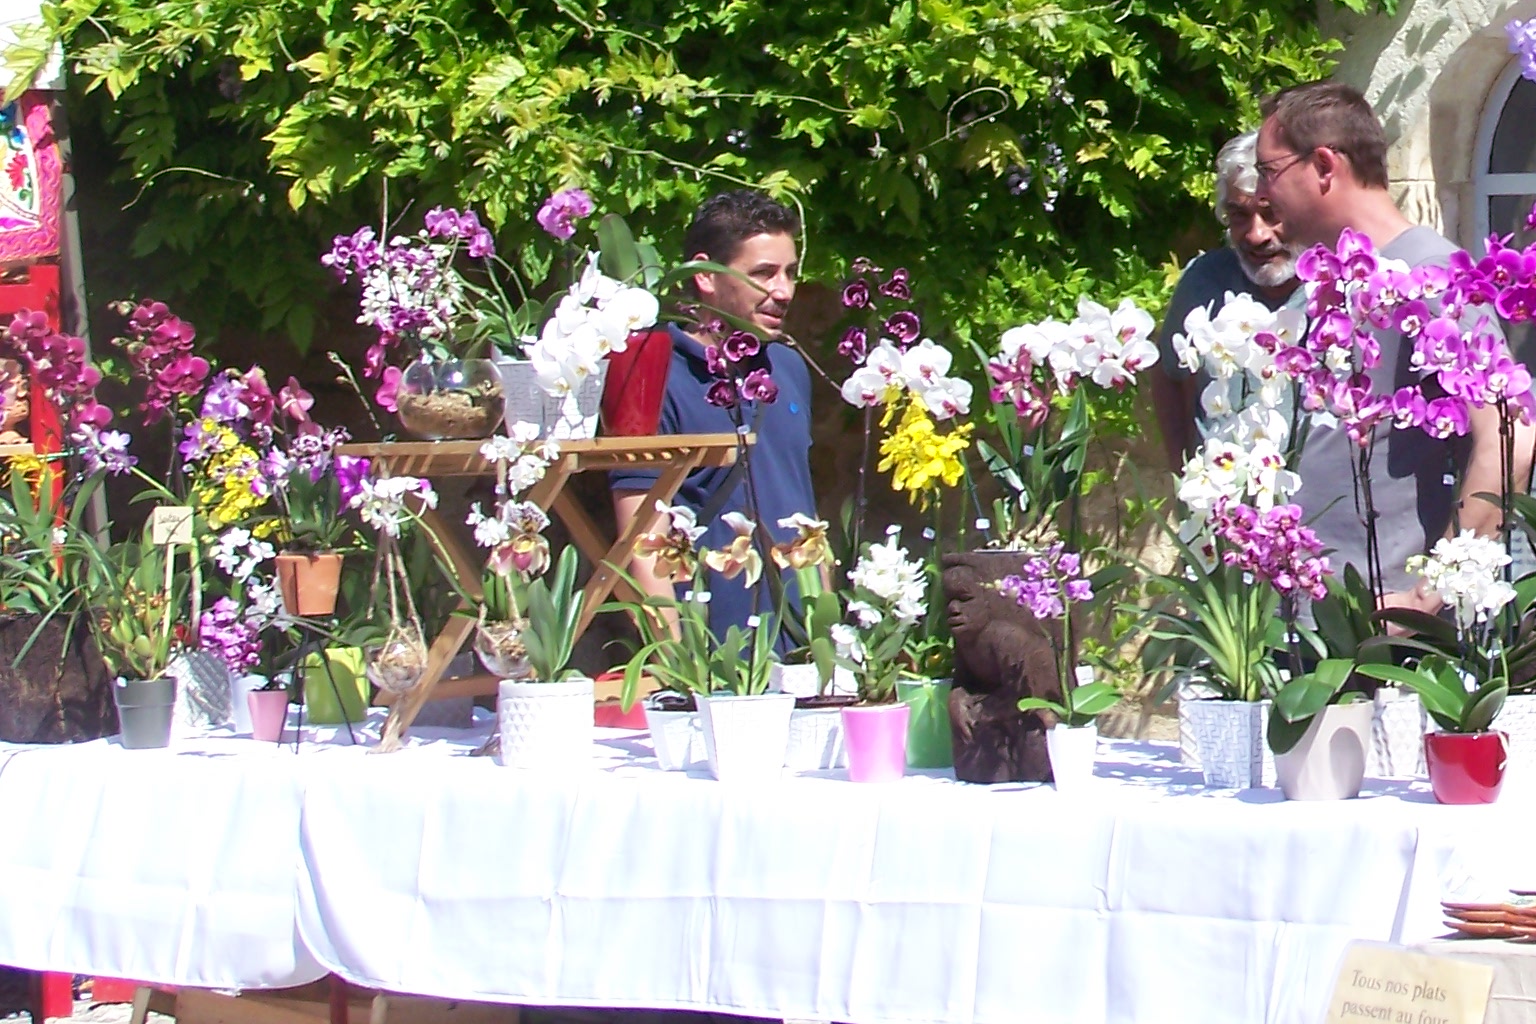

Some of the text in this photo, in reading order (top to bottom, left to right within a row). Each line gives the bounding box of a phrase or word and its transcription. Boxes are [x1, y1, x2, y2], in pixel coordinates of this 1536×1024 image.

[1352, 969, 1447, 1003] Tous nos plats
[1341, 1001, 1392, 1021] passent
[1395, 1010, 1413, 1024] au
